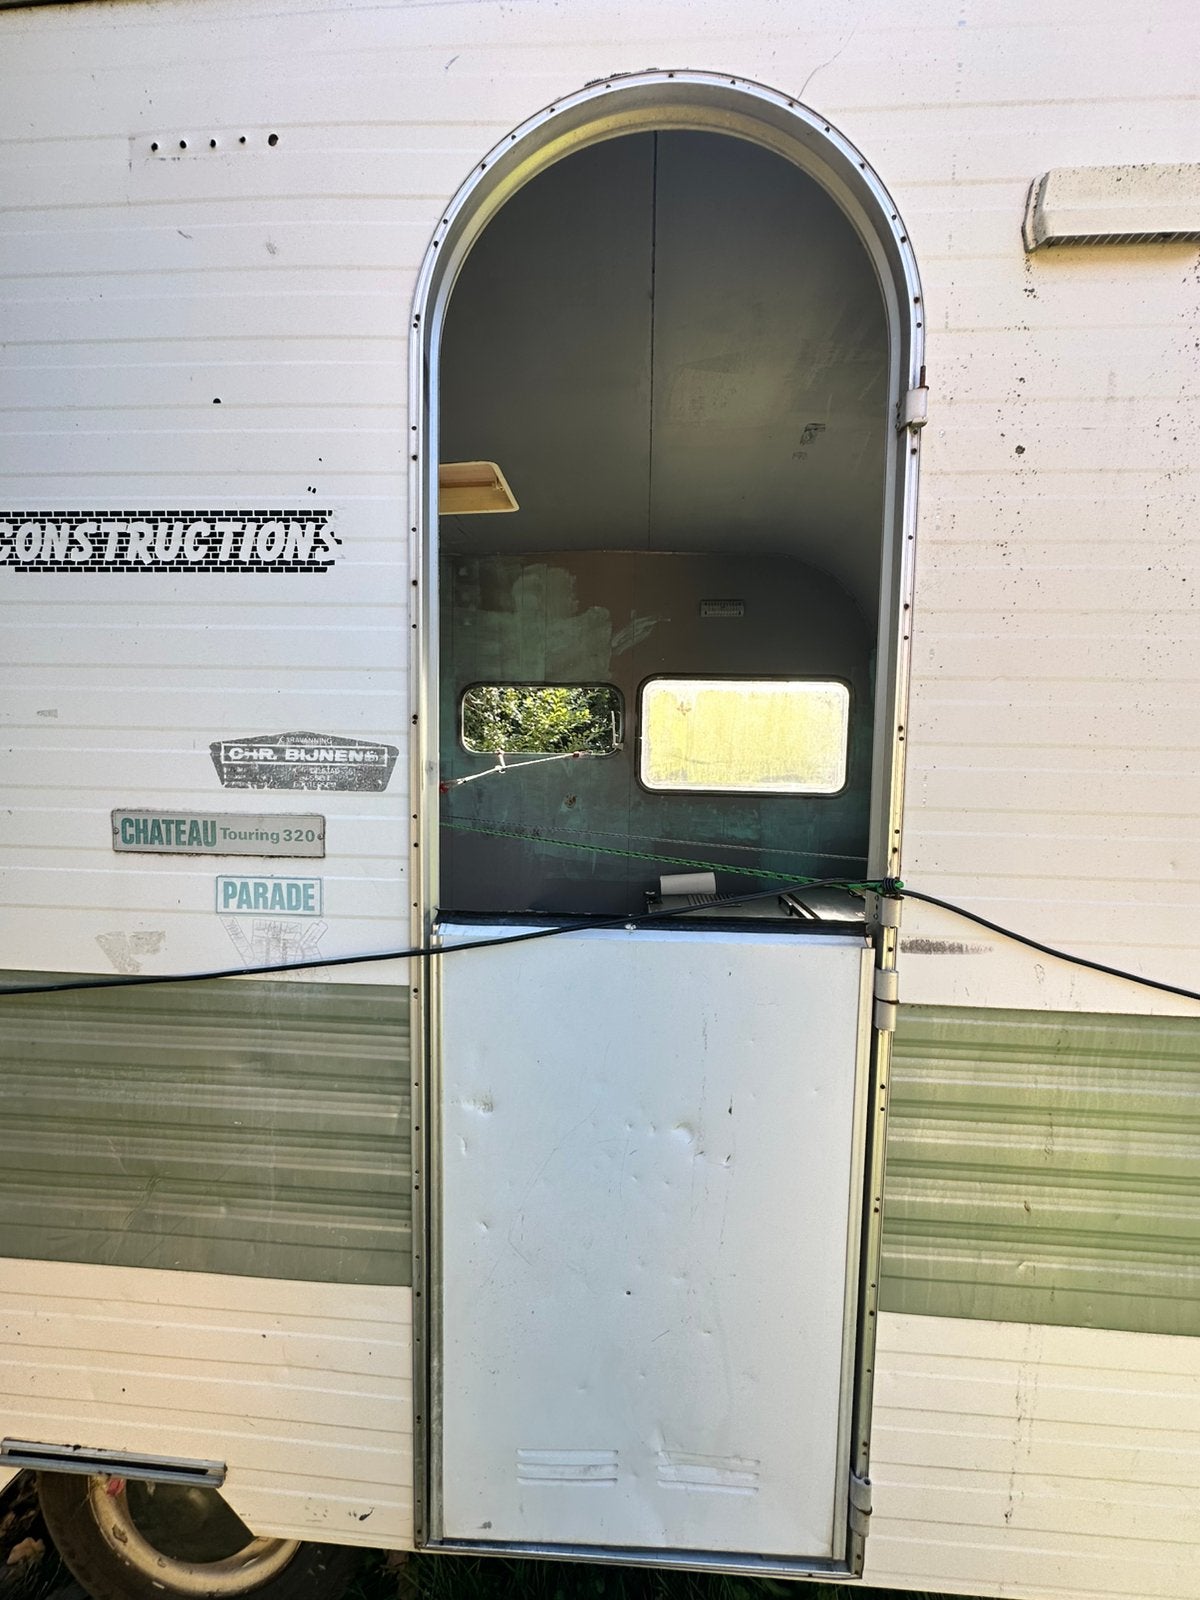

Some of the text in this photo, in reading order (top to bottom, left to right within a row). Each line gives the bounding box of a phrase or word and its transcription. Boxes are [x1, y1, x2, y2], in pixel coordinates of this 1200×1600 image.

[120, 817, 316, 847] CHATEAU Touring 320
[222, 881, 316, 912] PARADE
